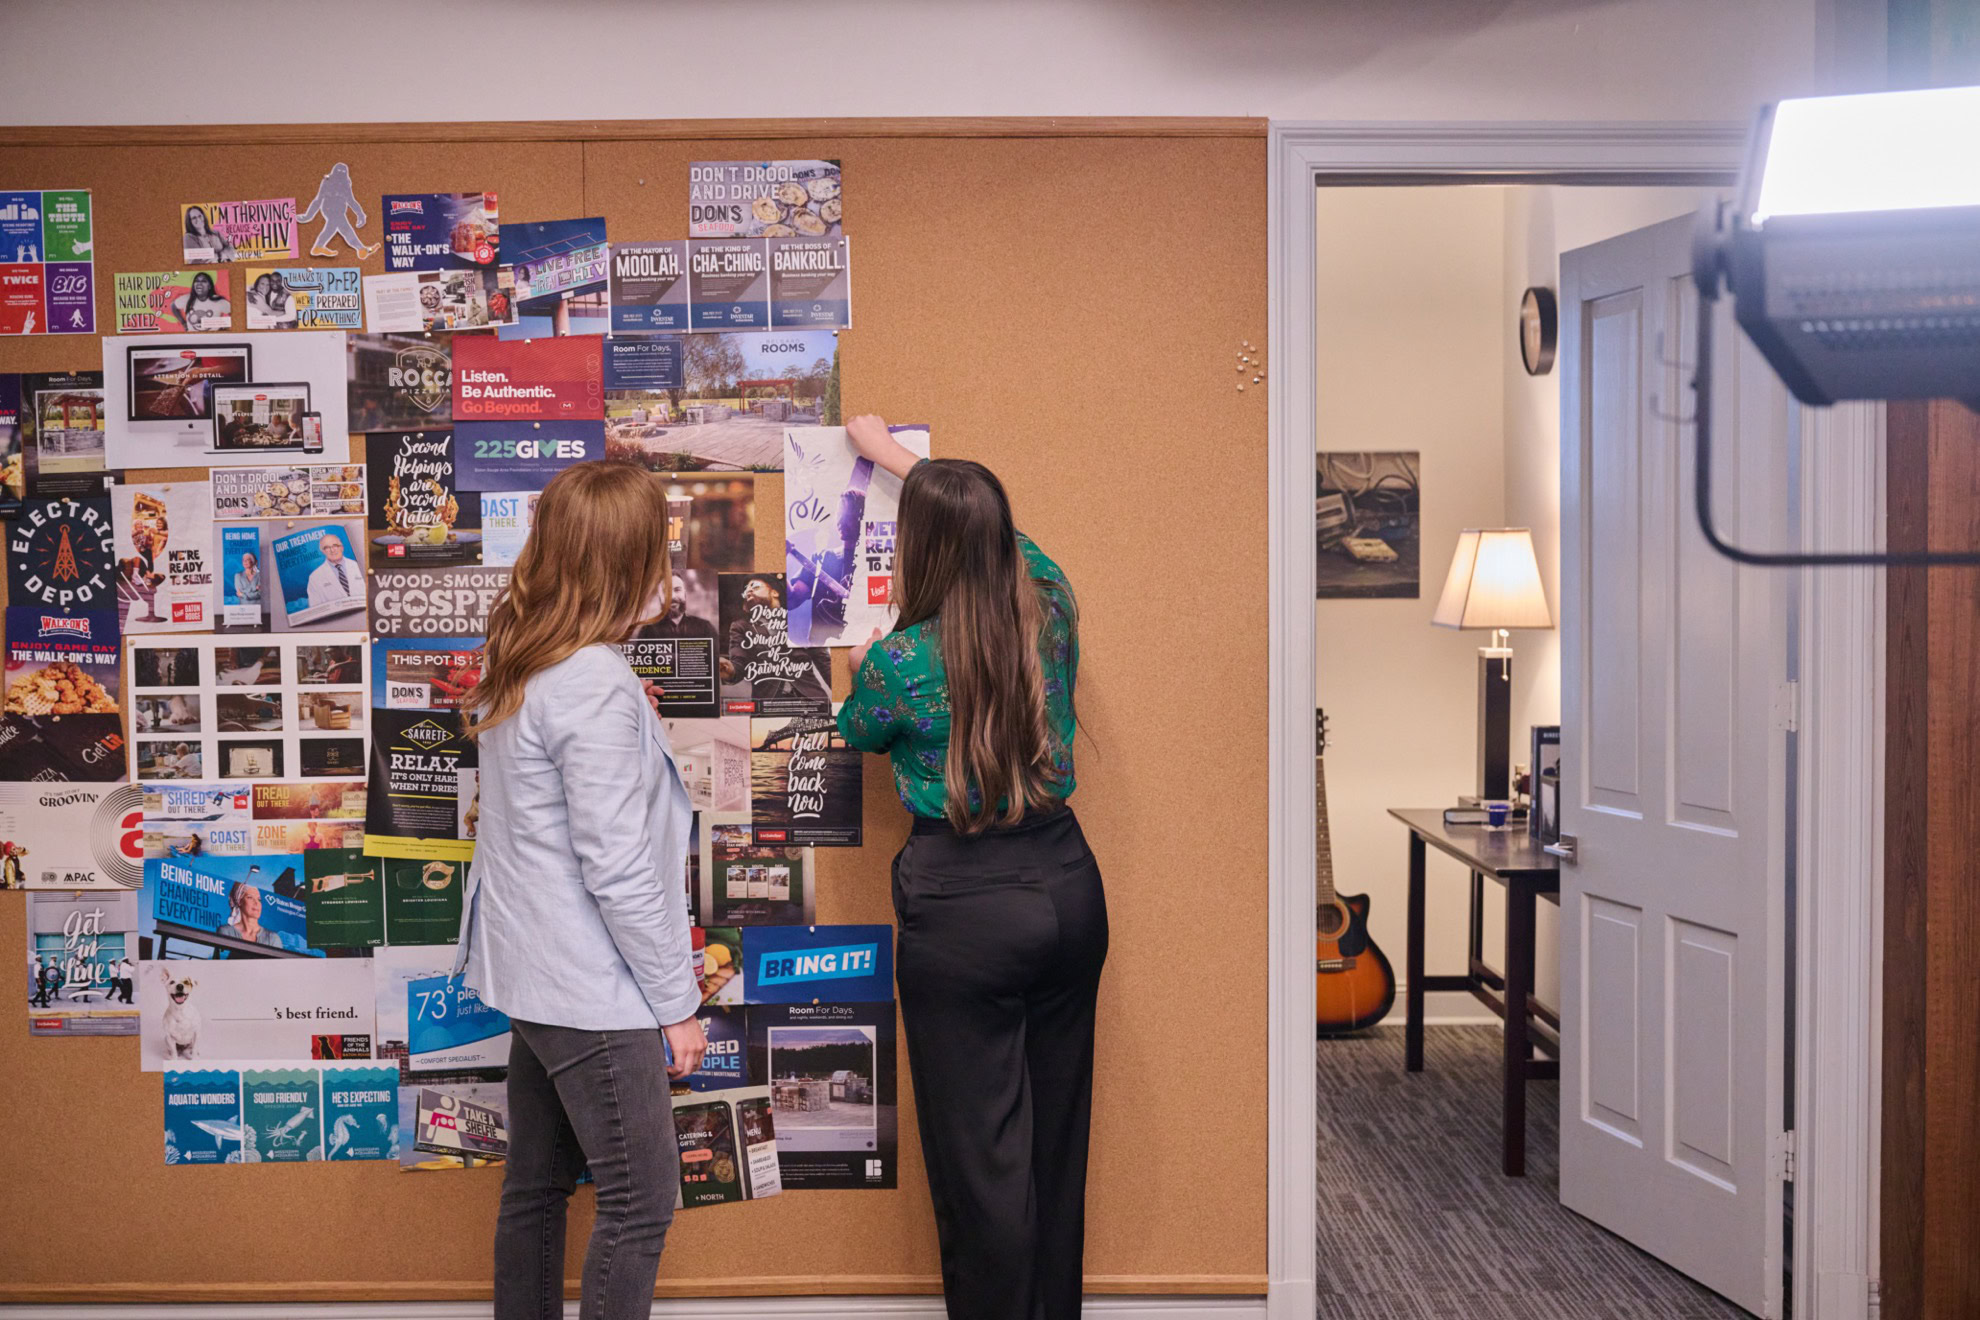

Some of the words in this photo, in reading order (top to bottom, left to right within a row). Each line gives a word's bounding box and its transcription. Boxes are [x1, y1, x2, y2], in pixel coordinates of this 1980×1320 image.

[691, 166, 738, 182] DON'T
[743, 165, 798, 182] DROOL
[691, 184, 725, 200] AND
[731, 183, 780, 200] DRIVE
[691, 204, 744, 224] DON'S
[697, 223, 735, 232] SEAFOOD
[261, 222, 290, 248] HIV
[391, 233, 411, 244] THE
[391, 244, 450, 256] WALK-ON'S
[392, 257, 415, 268] WAY
[535, 258, 563, 276] LIVE
[616, 254, 684, 277] MOOLAH.
[693, 253, 766, 273] CHA-CHING.
[774, 251, 845, 271] BANKROLL.
[573, 261, 606, 283] HIV
[3, 275, 39, 285] TWICE
[52, 275, 87, 293] BIG
[118, 274, 142, 291] HAIR
[120, 293, 147, 309] NAILS
[317, 295, 357, 308] PREPARED
[296, 309, 318, 327] FOR
[761, 343, 805, 353] ROOMS
[461, 370, 509, 383] Listen.
[461, 386, 482, 398] Be
[483, 385, 556, 398] Authentic.
[461, 401, 483, 414] Go
[485, 400, 543, 416] Beyond.
[399, 435, 451, 456] Second
[394, 454, 453, 481] Helpings
[215, 473, 247, 484] DON'T
[248, 472, 282, 483] DROOL
[216, 484, 239, 494] AND
[240, 483, 272, 494] DRIVE
[409, 479, 434, 492] are
[216, 497, 248, 509] DON'S
[397, 486, 449, 509] Second
[12, 501, 114, 554] ELECTRIC
[225, 532, 241, 540] BEING
[241, 532, 256, 540] HOME
[275, 541, 289, 552] OUR
[290, 529, 326, 547] TREATMENT
[168, 549, 200, 561] WE'RE
[169, 561, 203, 574] READY
[375, 574, 512, 588] WOOD-SMOKE
[24, 573, 106, 606] DEPOT
[375, 618, 403, 633] OF
[12, 642, 51, 650] ENJOY
[54, 643, 89, 651] GAME
[638, 643, 672, 654] OPEN
[12, 650, 32, 661] THE
[35, 651, 93, 664] WALK-ON'S
[94, 654, 117, 665] WAY
[392, 654, 421, 665] THIS
[425, 655, 451, 665] POT
[454, 656, 465, 665] IS
[656, 655, 673, 665] OF
[744, 660, 780, 681] Baton
[779, 657, 813, 678] Rouge
[392, 686, 424, 699] DON'S
[407, 728, 448, 741] SAKRETE
[390, 753, 459, 773] RELAX
[391, 772, 408, 780] IT'S
[409, 773, 433, 782] ONLY
[434, 774, 458, 783] HARD
[787, 771, 828, 794] back
[255, 787, 290, 799] TREAD
[389, 782, 419, 791] WHEN
[420, 783, 430, 792] IT
[431, 784, 458, 793] DRIES
[39, 793, 98, 807] GROOVIN'
[168, 791, 206, 805] SHRED
[168, 806, 181, 814] OUT
[210, 830, 247, 844] COAST
[257, 826, 287, 839] ZONE
[161, 862, 193, 887] BEING
[195, 873, 225, 896] HOME
[160, 880, 209, 908] CHANGED
[159, 898, 221, 928] EVERYTHING
[764, 953, 837, 978] BRING
[841, 950, 871, 971] IT!
[286, 1007, 312, 1019] best
[316, 1006, 358, 1019] friend.
[456, 1003, 472, 1018] just
[474, 1003, 488, 1013] like
[448, 1055, 480, 1063] SPECIALIST
[168, 1093, 199, 1105] AQUATIC
[200, 1093, 235, 1105] WONDERS
[253, 1092, 275, 1104] SQUID
[276, 1091, 308, 1103] FRIENDLY
[331, 1092, 349, 1104] HE'S
[350, 1091, 391, 1103] EXPECTING
[464, 1106, 487, 1125] TAKE
[488, 1114, 496, 1126] A
[465, 1121, 497, 1138] SHELFIE
[679, 1131, 708, 1140] CATERING
[746, 1127, 762, 1137] MENU
